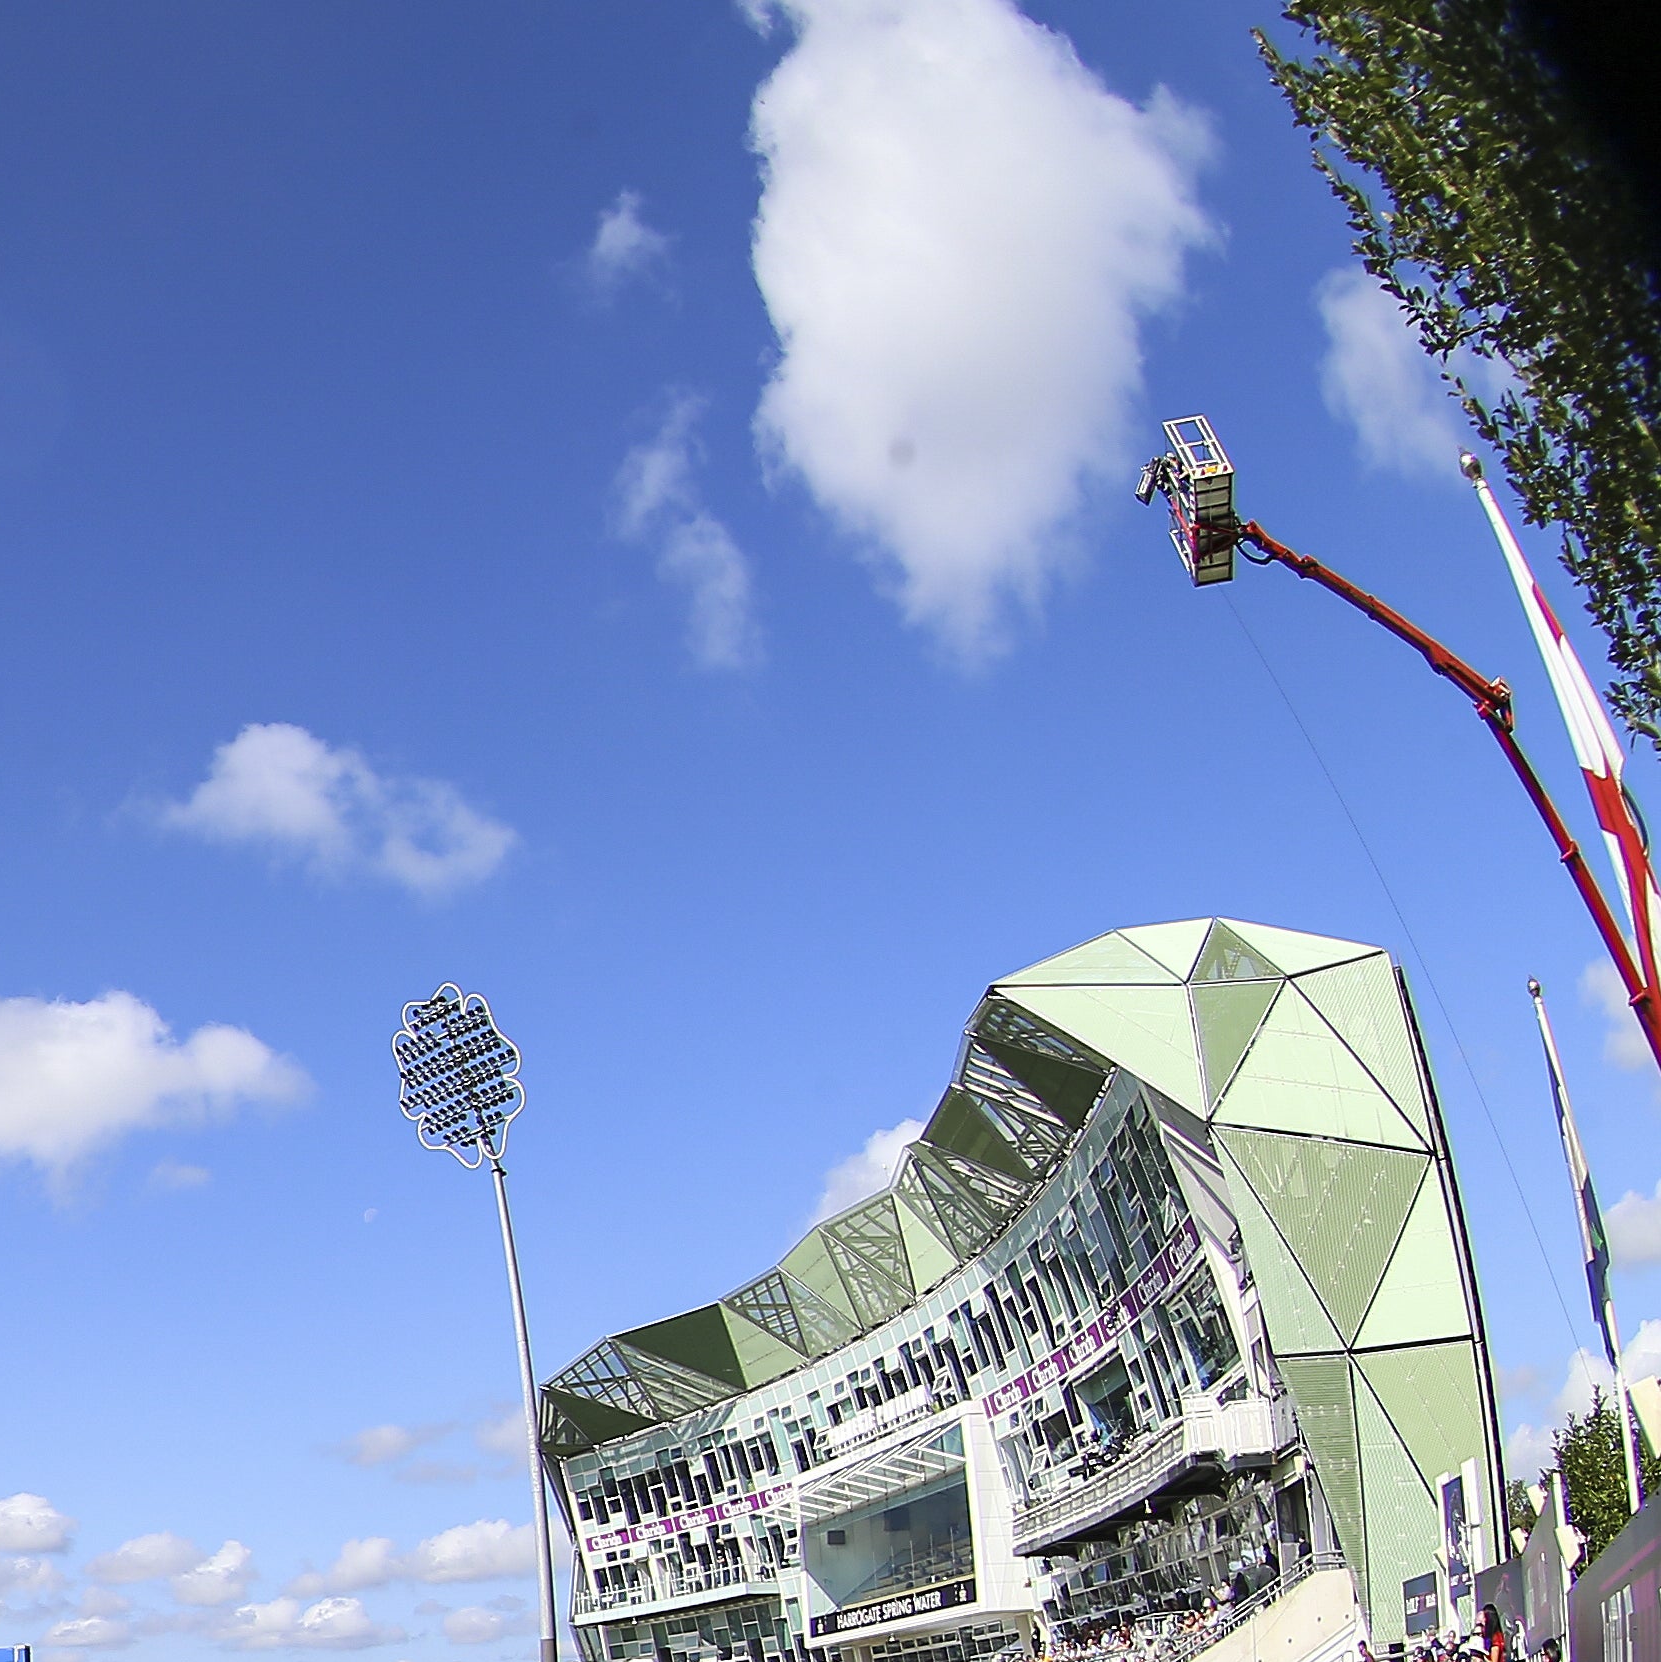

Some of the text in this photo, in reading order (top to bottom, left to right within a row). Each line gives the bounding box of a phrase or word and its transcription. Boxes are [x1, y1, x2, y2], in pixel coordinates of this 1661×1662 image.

[836, 1591, 942, 1630] HARROGATE SPRING WATER
